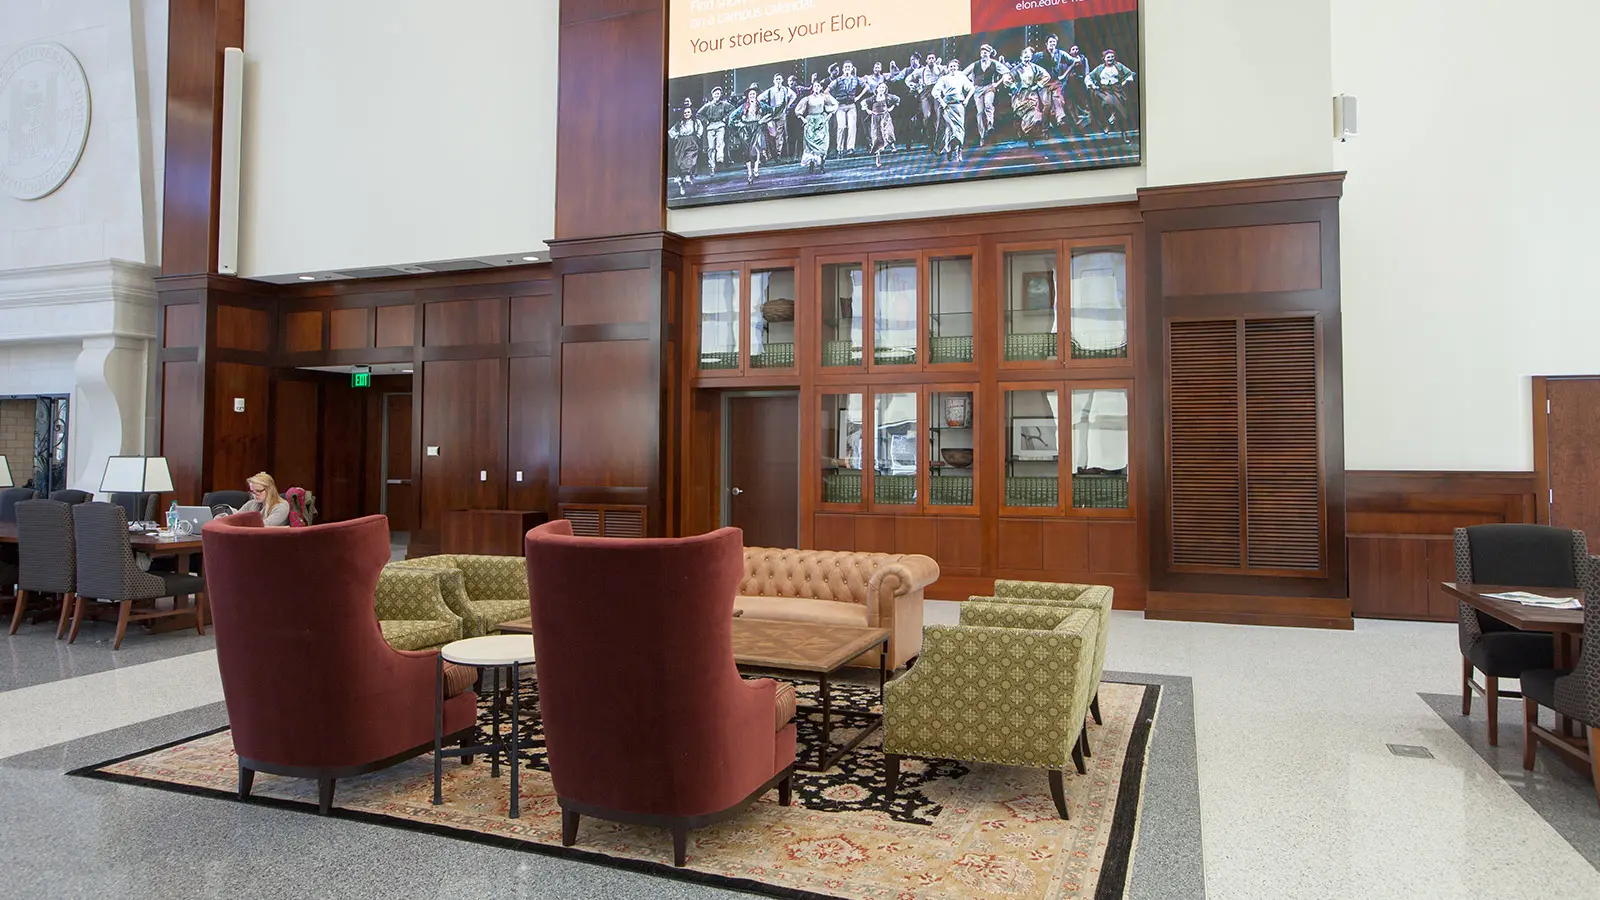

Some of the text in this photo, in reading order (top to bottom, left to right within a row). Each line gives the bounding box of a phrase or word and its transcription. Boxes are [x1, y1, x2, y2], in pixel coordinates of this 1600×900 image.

[716, 8, 763, 24] campus
[690, 13, 872, 54] Your stories, your Elon.
[355, 373, 369, 387] EXIT
